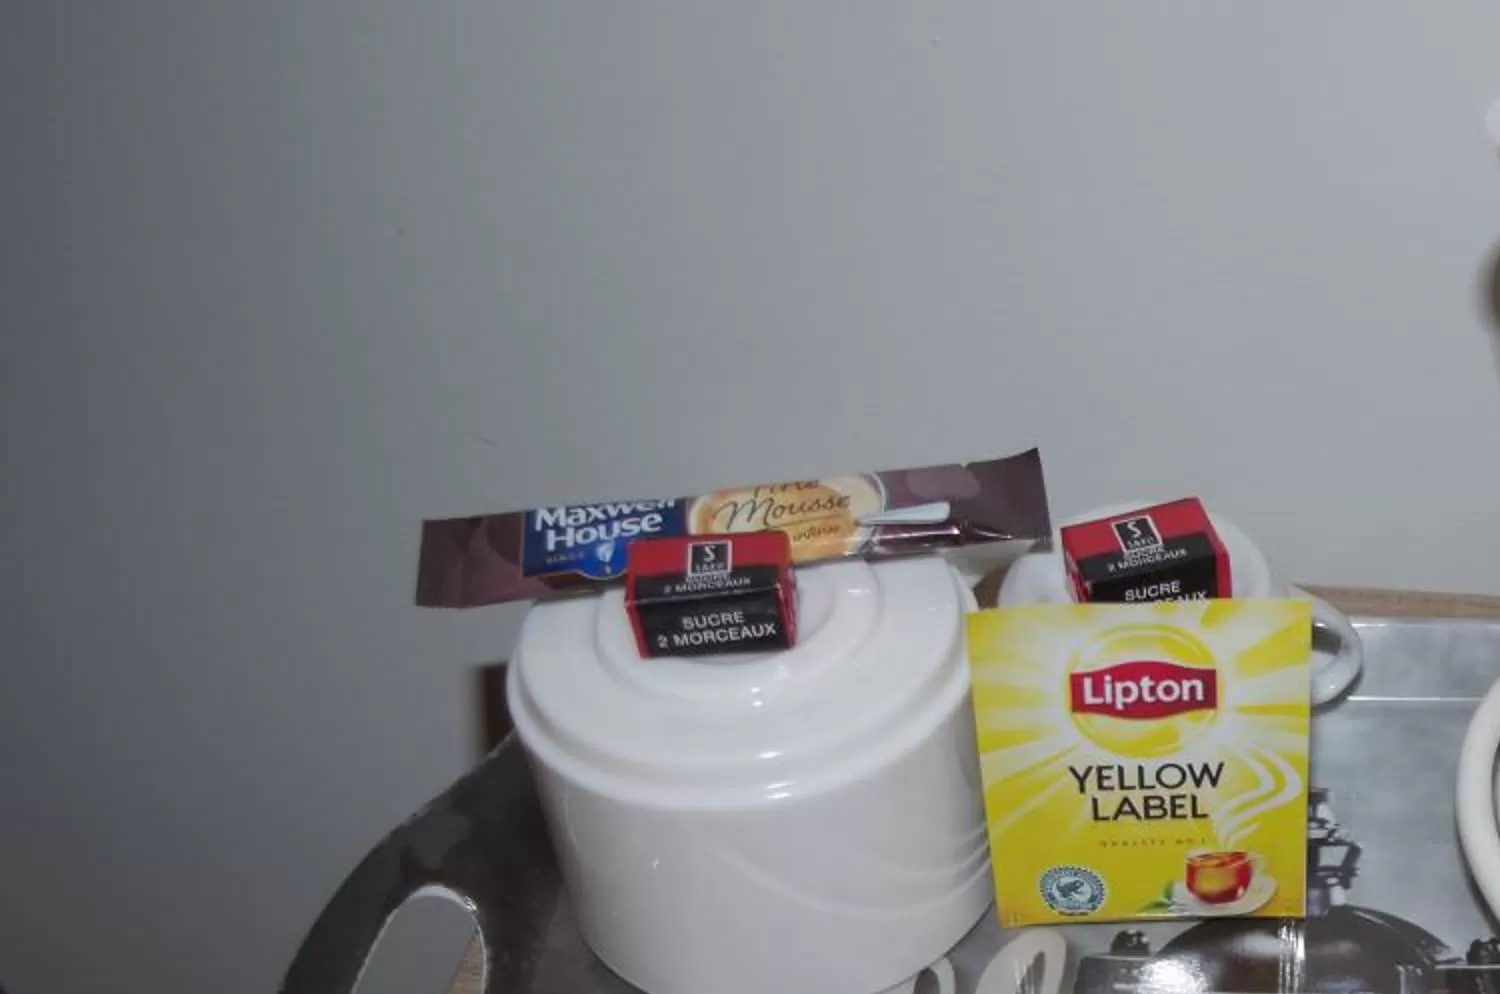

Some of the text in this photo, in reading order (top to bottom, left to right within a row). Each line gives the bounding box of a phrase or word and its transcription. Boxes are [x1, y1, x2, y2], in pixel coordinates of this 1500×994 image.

[712, 495, 850, 530] Mousse
[546, 512, 663, 551] House
[1124, 579, 1181, 602] SUCRE
[657, 622, 777, 649] 2 MORCEAUX
[681, 611, 745, 630] SUCRE
[1082, 674, 1205, 711] Lipton
[1068, 761, 1225, 795] YELLOW
[1091, 793, 1210, 822] LABEL
